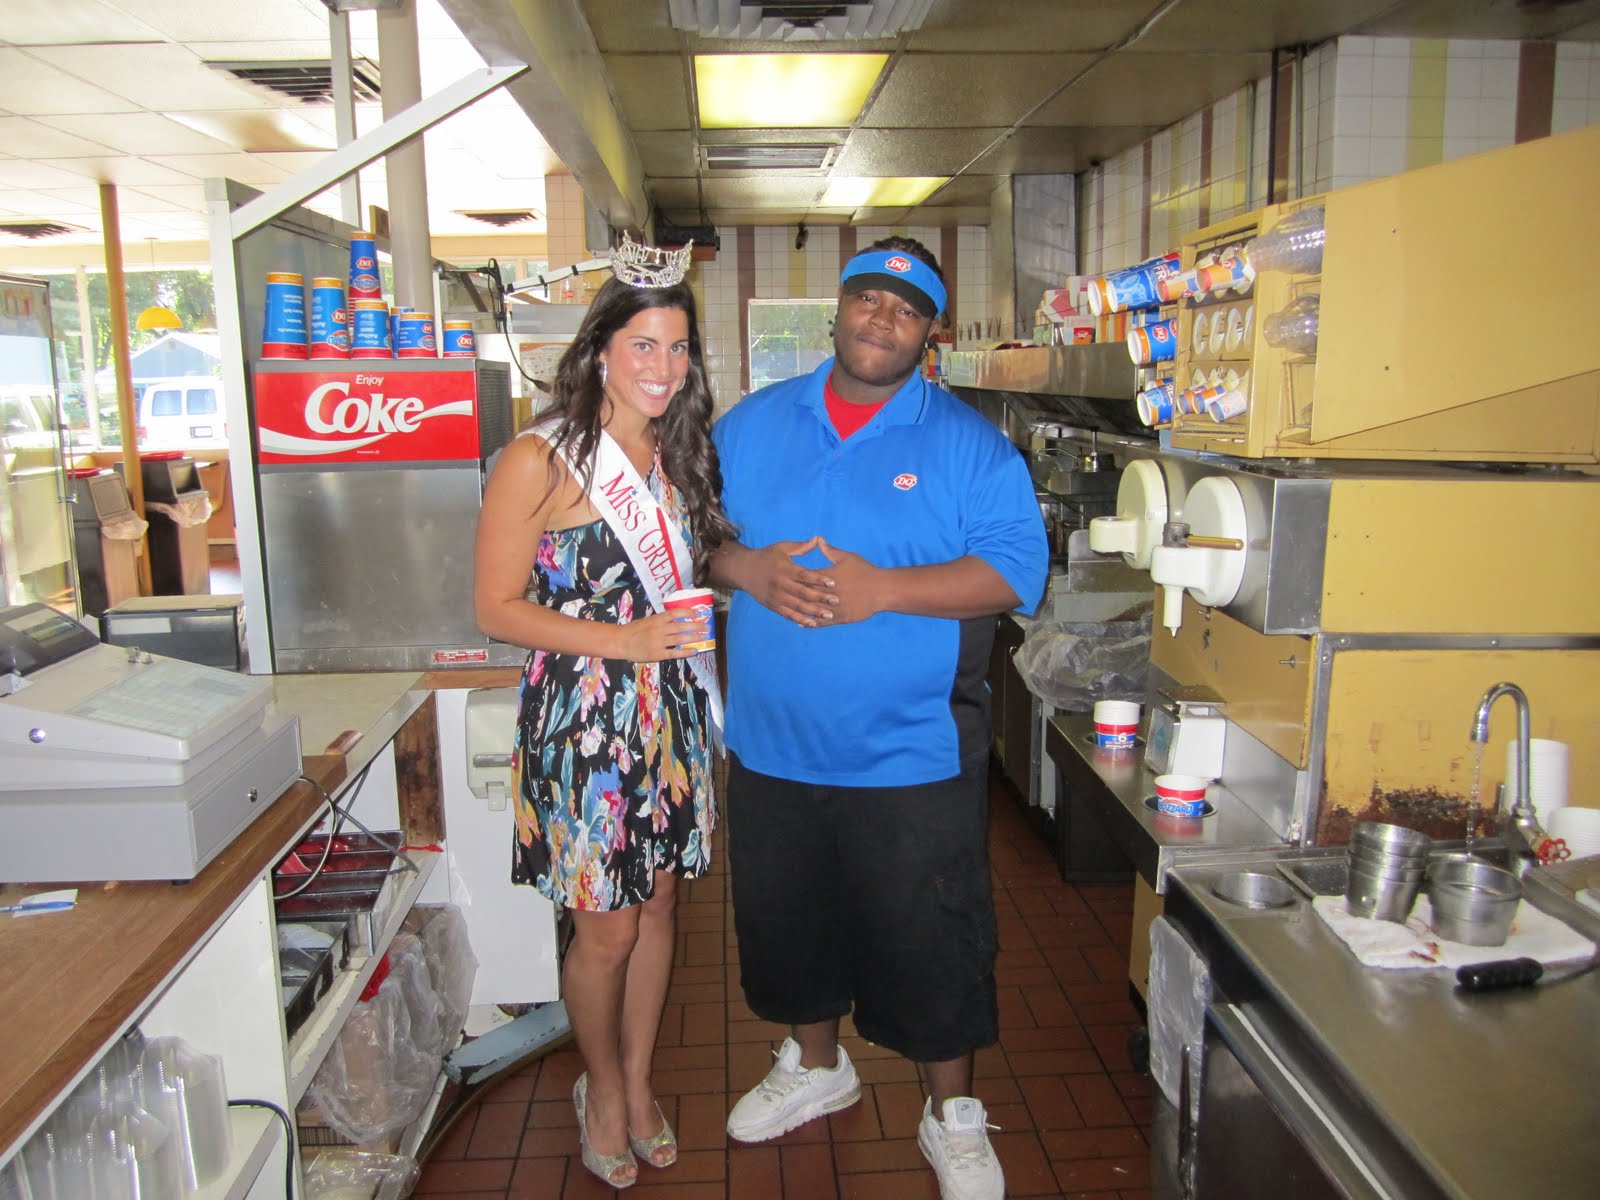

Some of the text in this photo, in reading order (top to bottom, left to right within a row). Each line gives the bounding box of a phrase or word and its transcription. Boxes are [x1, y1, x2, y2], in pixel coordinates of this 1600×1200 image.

[356, 374, 384, 387] Enjoy
[305, 382, 425, 433] Coke
[1117, 732, 1127, 742] 6
